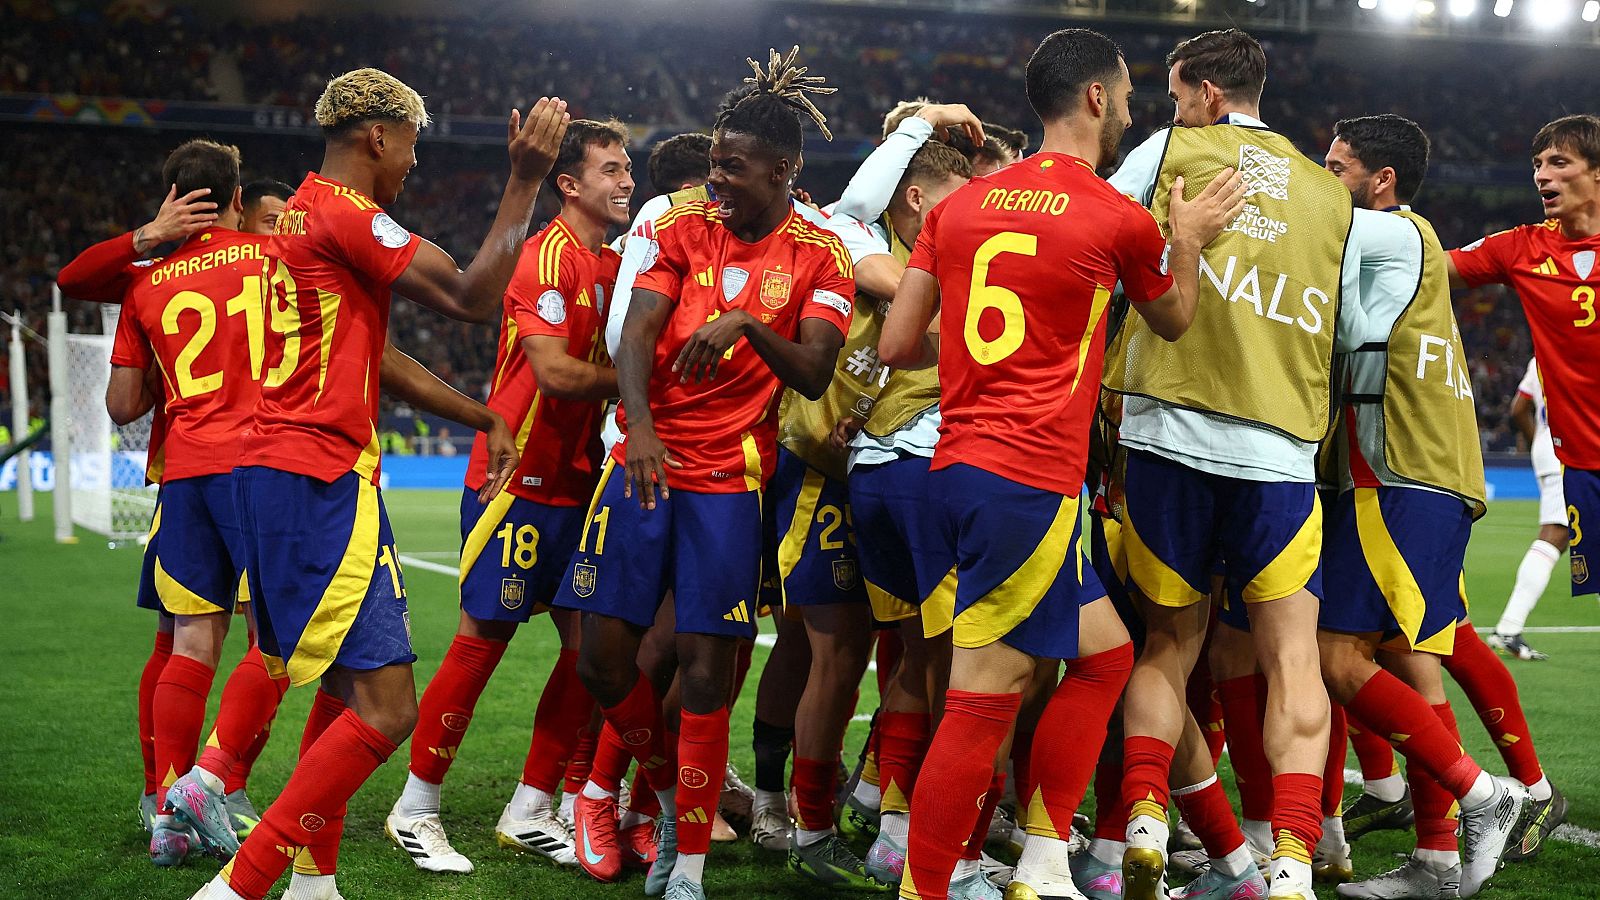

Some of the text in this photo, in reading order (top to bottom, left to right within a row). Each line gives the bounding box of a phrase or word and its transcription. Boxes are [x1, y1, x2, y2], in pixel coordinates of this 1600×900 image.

[981, 188, 1070, 216] MERINO
[1234, 212, 1288, 234] ATIONS
[1243, 203, 1260, 216] EFA
[151, 243, 265, 286] OYARZABAL
[964, 231, 1037, 365] 6
[1198, 255, 1329, 334] NALS
[1571, 285, 1597, 327] 3
[161, 275, 263, 399] 21
[497, 522, 540, 570] 18
[1567, 504, 1583, 547] 3
